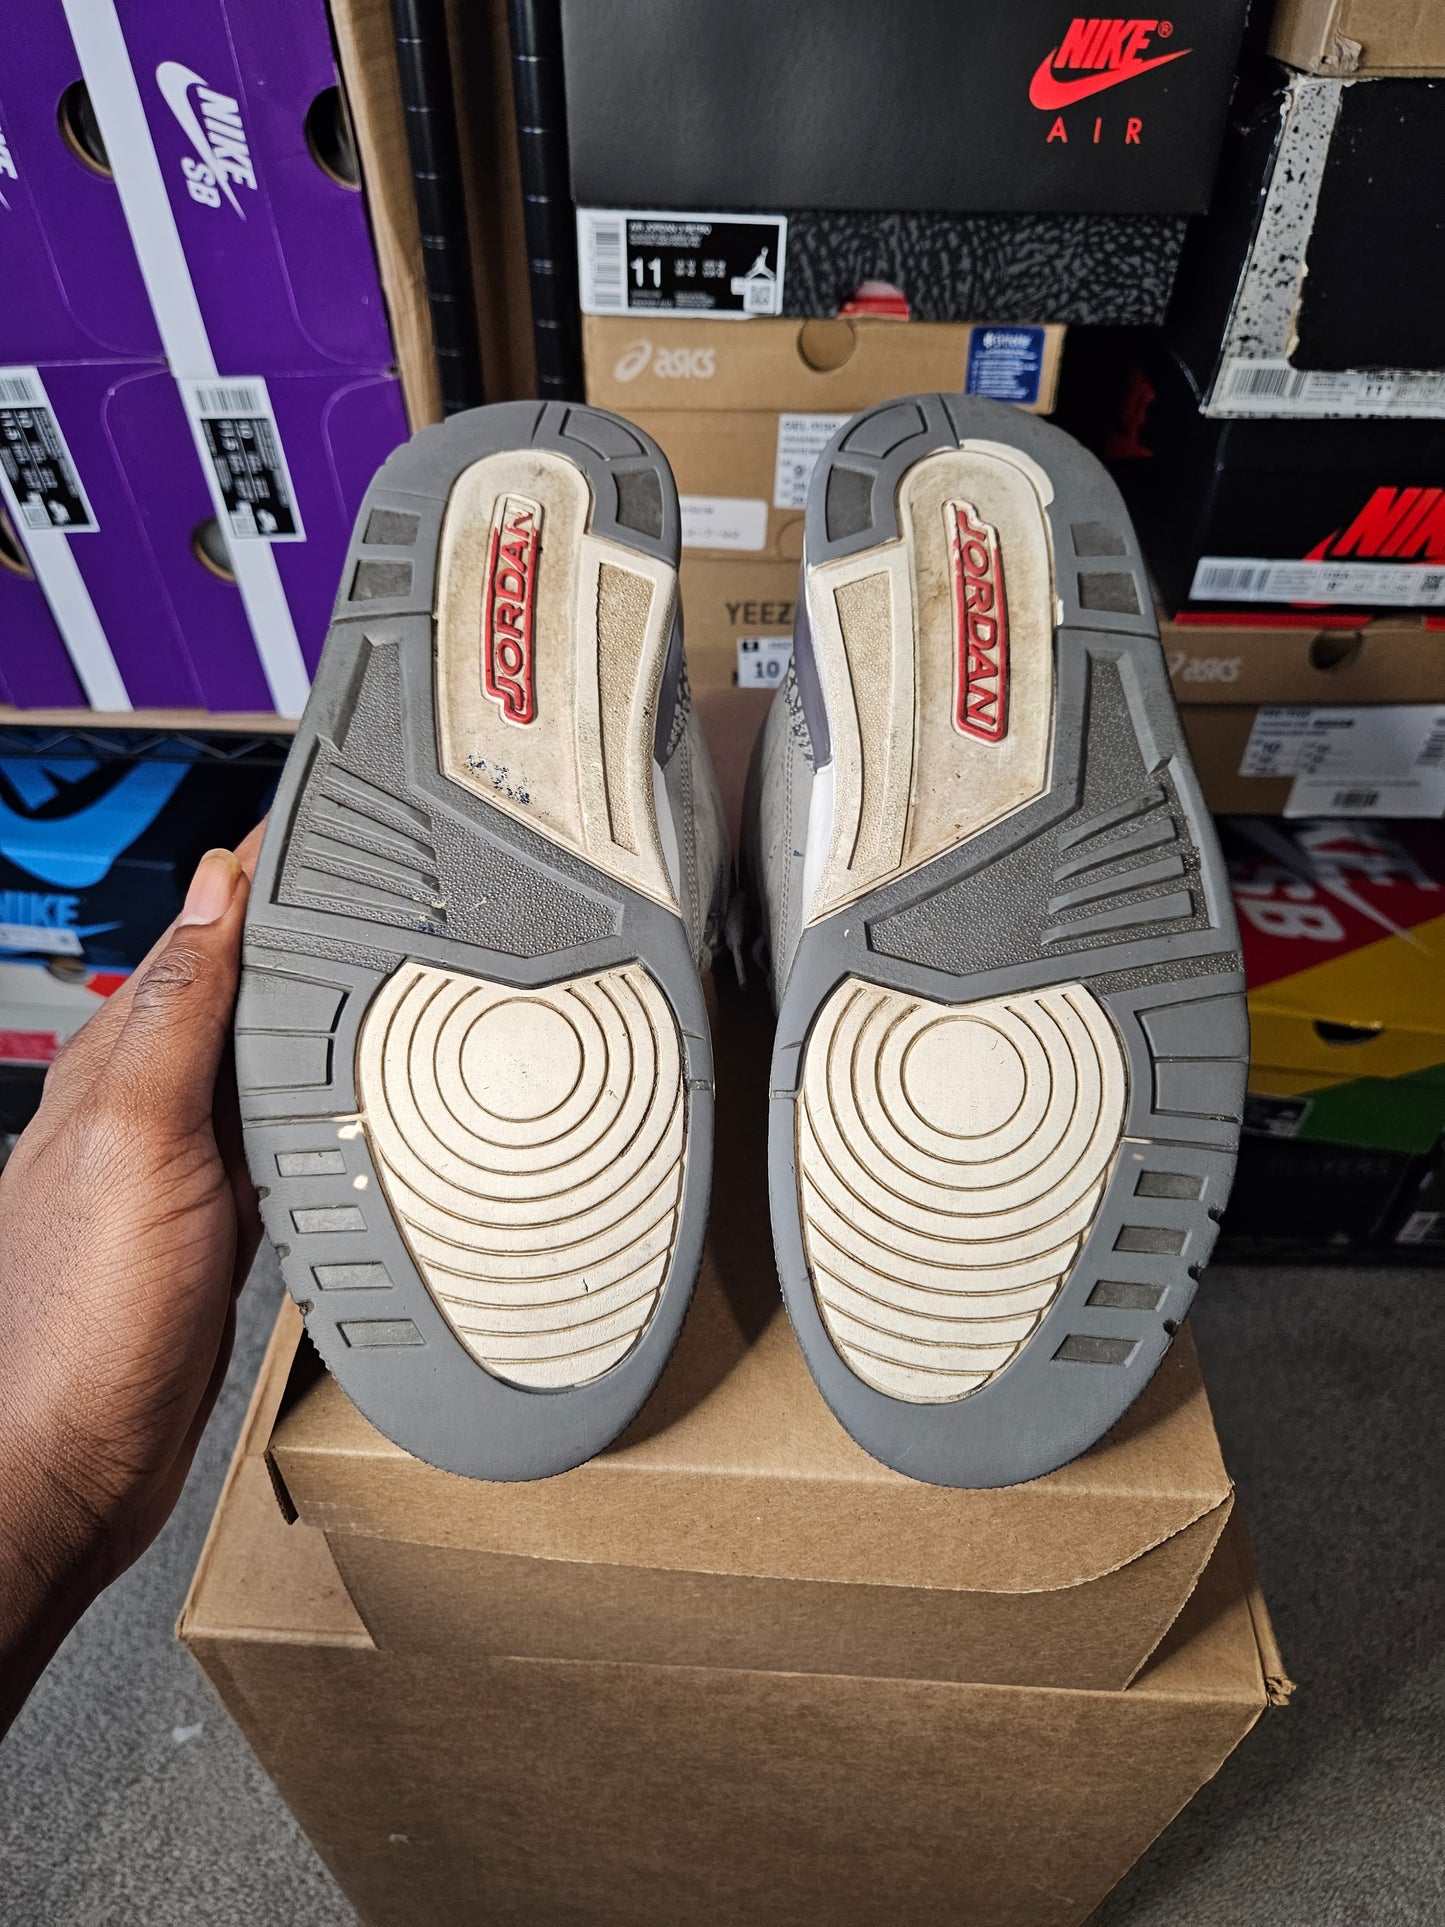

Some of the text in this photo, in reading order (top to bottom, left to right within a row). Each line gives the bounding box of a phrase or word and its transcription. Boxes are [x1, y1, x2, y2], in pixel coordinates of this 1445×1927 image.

[1053, 18, 1159, 69] NIKE
[196, 86, 258, 191] NIKE
[1046, 115, 1143, 145] AIR
[180, 156, 221, 209] SB
[630, 256, 662, 288] 11
[1330, 486, 1445, 557] NIK
[496, 503, 534, 712] JORDAN
[726, 601, 794, 626] YEEZ
[956, 510, 999, 727] JORDAN
[755, 661, 780, 679] 10
